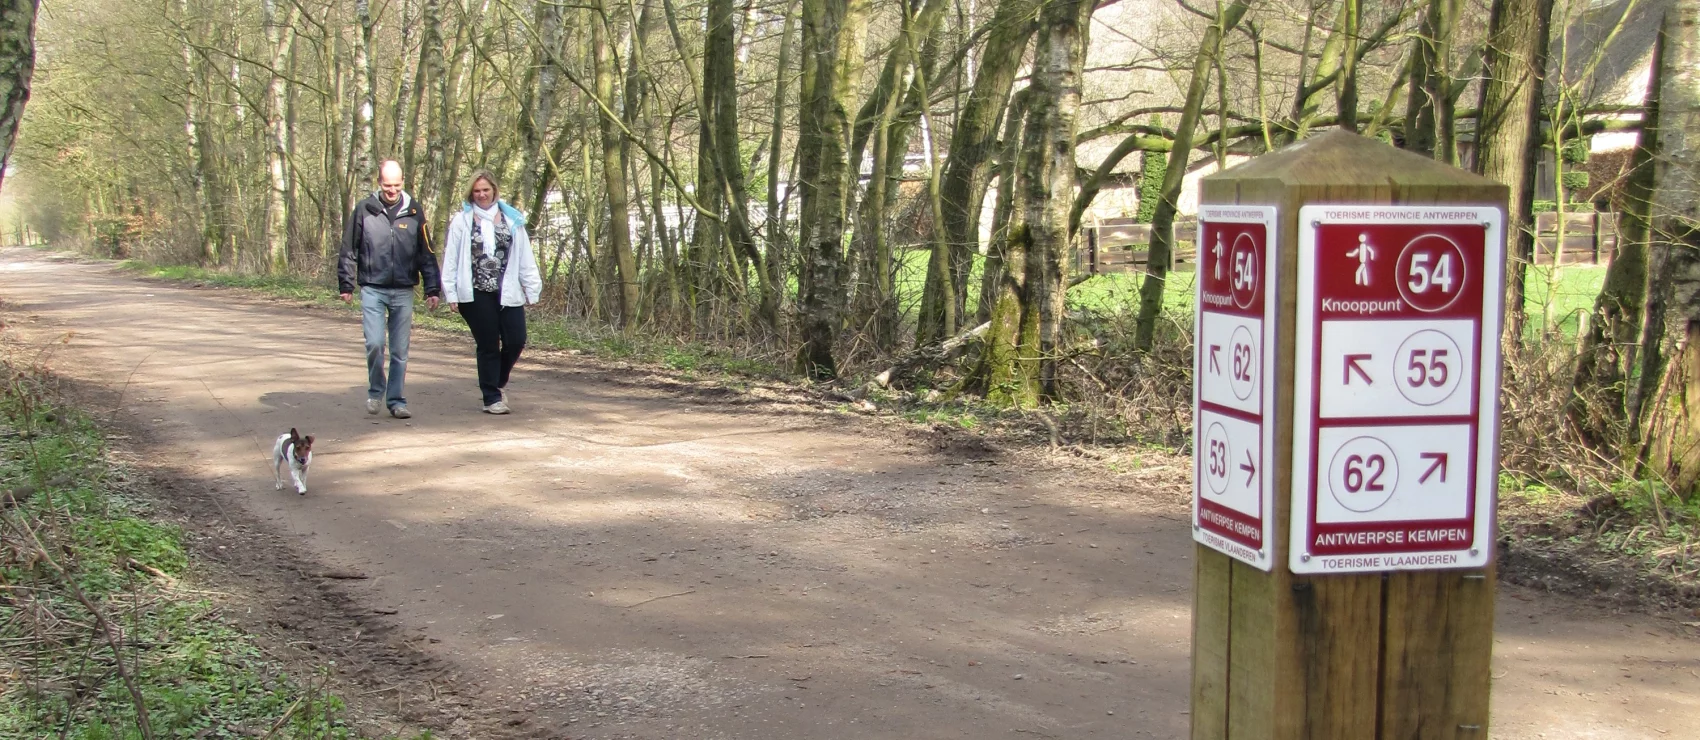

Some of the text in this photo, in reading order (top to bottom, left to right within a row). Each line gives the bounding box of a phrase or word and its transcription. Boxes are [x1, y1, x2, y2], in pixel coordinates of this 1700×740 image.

[1241, 210, 1264, 219] ANTWERPEN
[1325, 210, 1478, 220] TOERISME PROVINCIE ANTWERPEN
[1234, 252, 1253, 291] 54
[1408, 253, 1452, 294] 54
[1202, 290, 1232, 307] Knooppunt
[1322, 298, 1401, 314] Knooppunt
[1233, 342, 1251, 383] 62
[1406, 349, 1448, 388] 55
[1209, 439, 1226, 479] 53
[1343, 454, 1385, 494] 62
[1200, 507, 1260, 541] ANTWERPSE KEMPEN
[1315, 528, 1466, 546] ANTWERPSE KEMPEN
[1202, 532, 1256, 562] TOERISME VLAANDEREN
[1321, 554, 1457, 569] TOERISME VLAANDEREN
